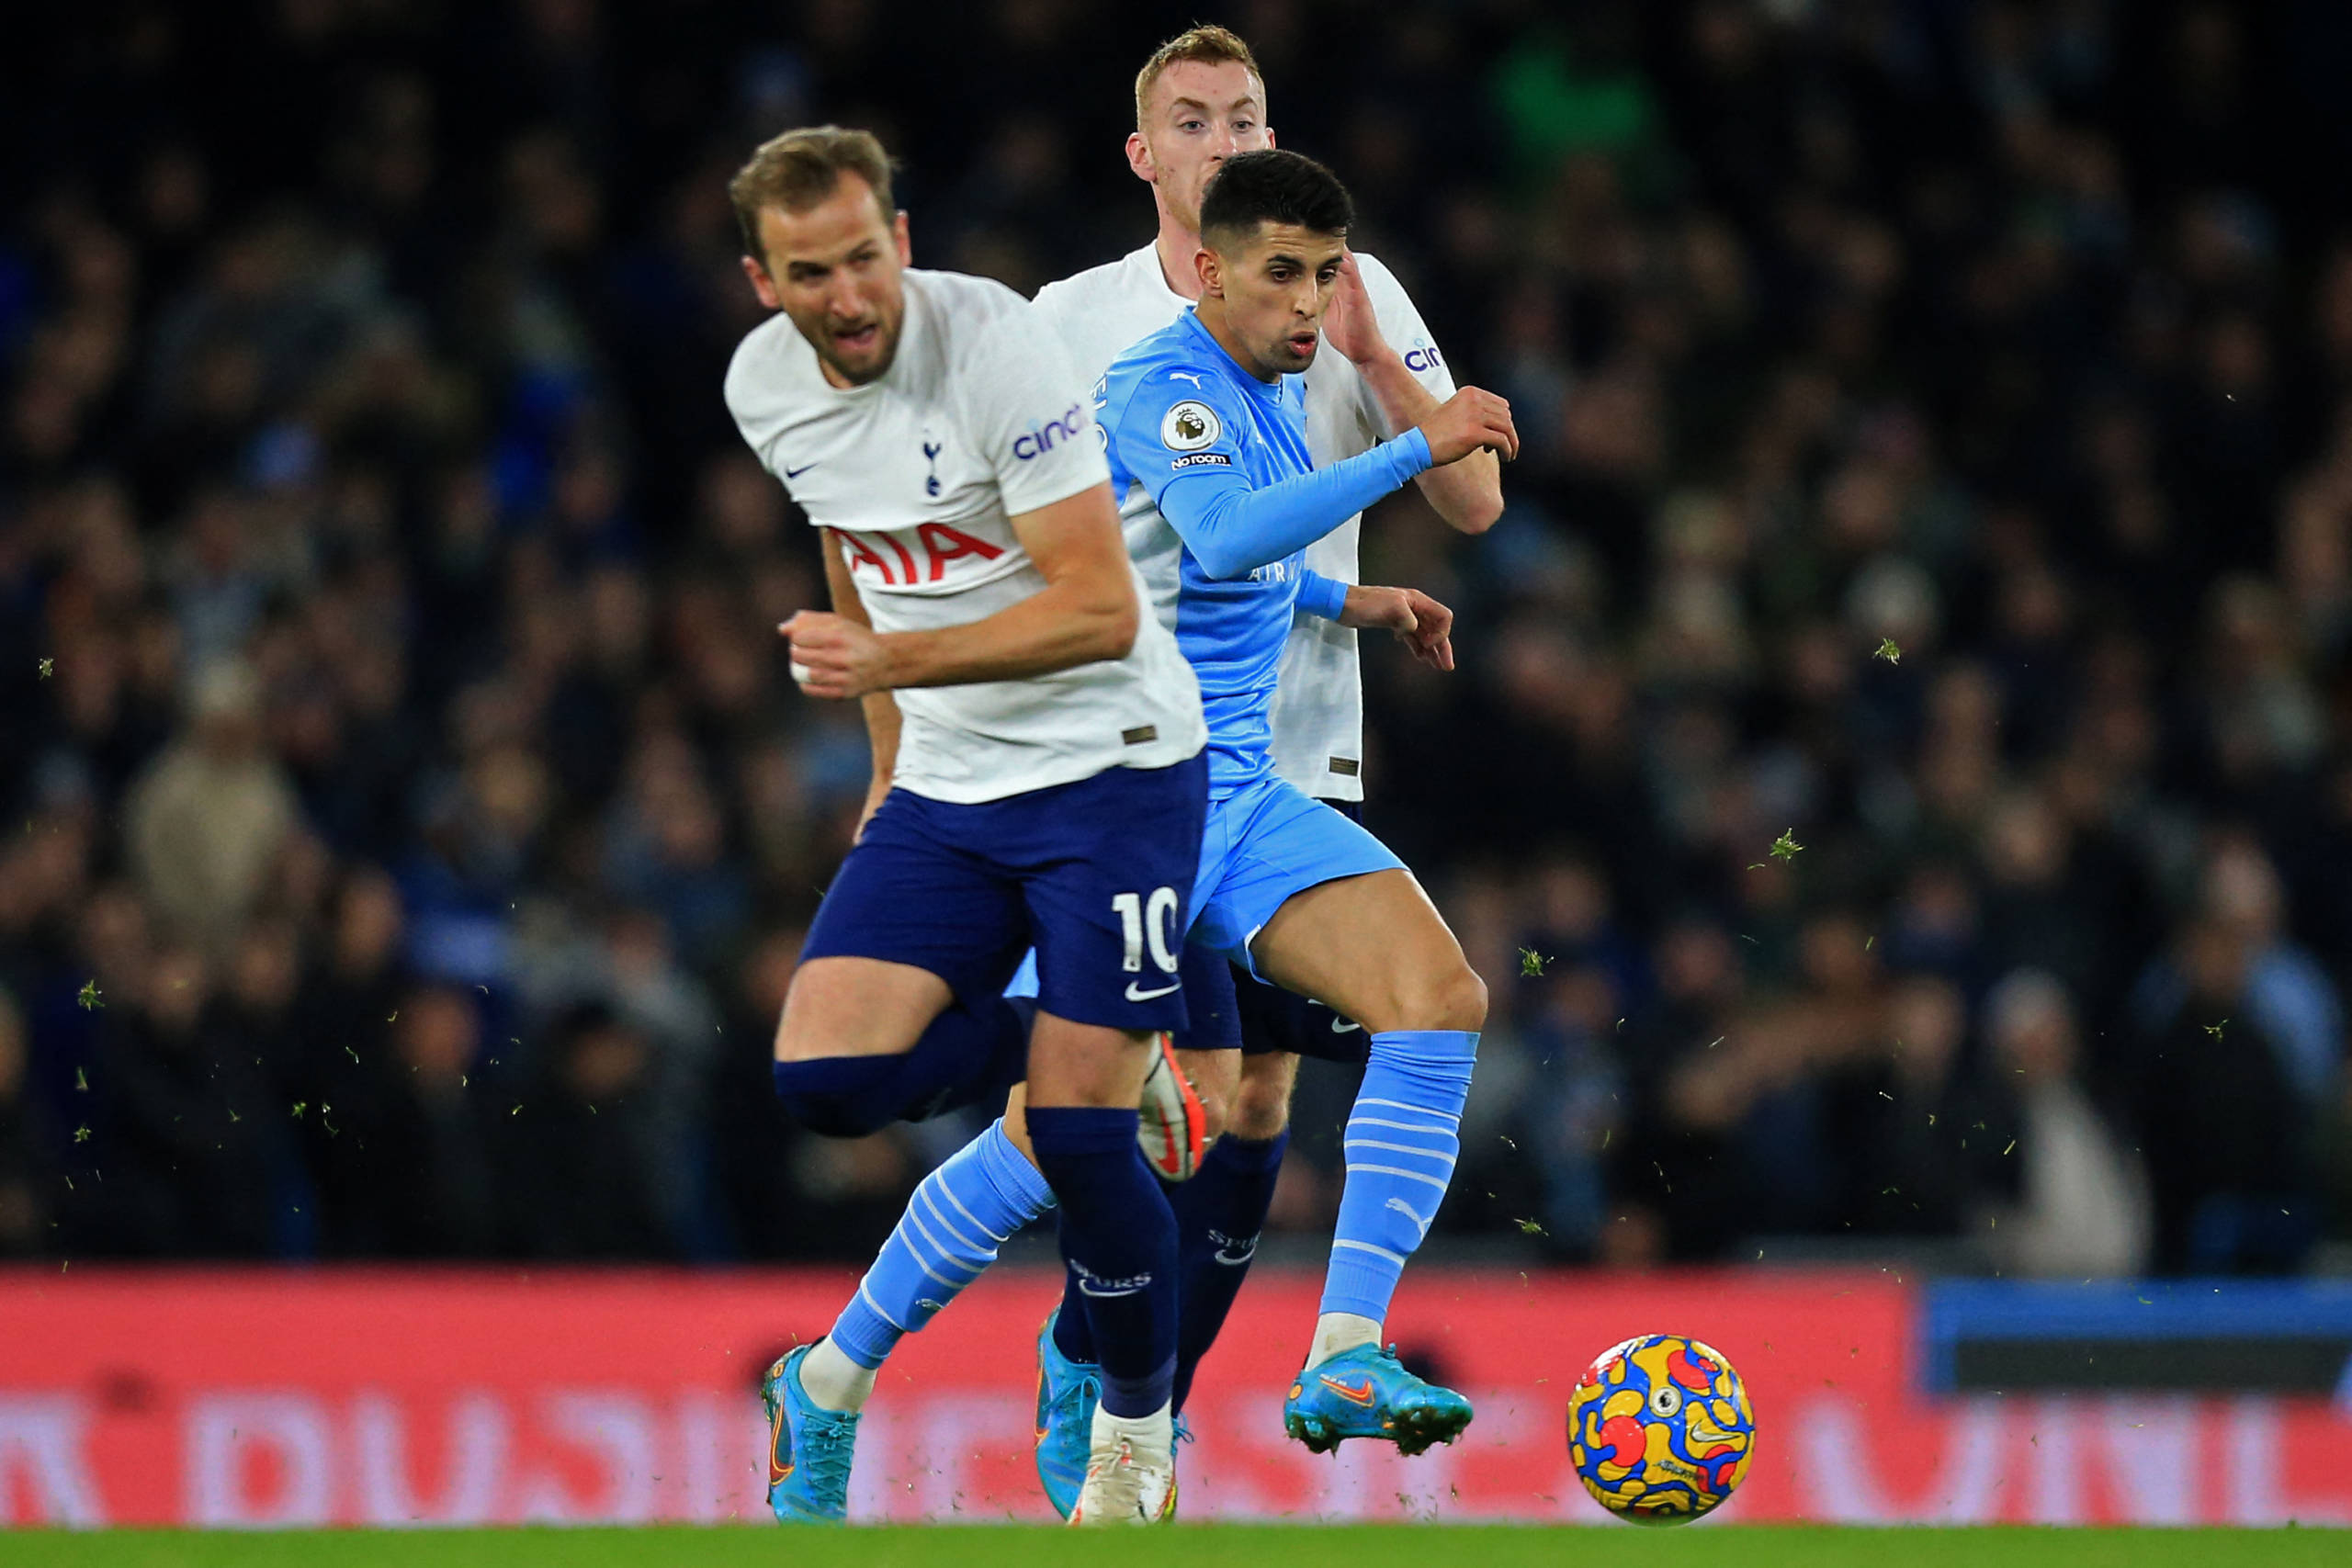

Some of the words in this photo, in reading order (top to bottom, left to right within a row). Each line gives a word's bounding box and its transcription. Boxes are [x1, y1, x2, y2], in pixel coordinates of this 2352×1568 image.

[1170, 457, 1191, 471] No
[1191, 454, 1227, 465] room
[829, 522, 1005, 585] AIA
[1112, 886, 1179, 974] 10
